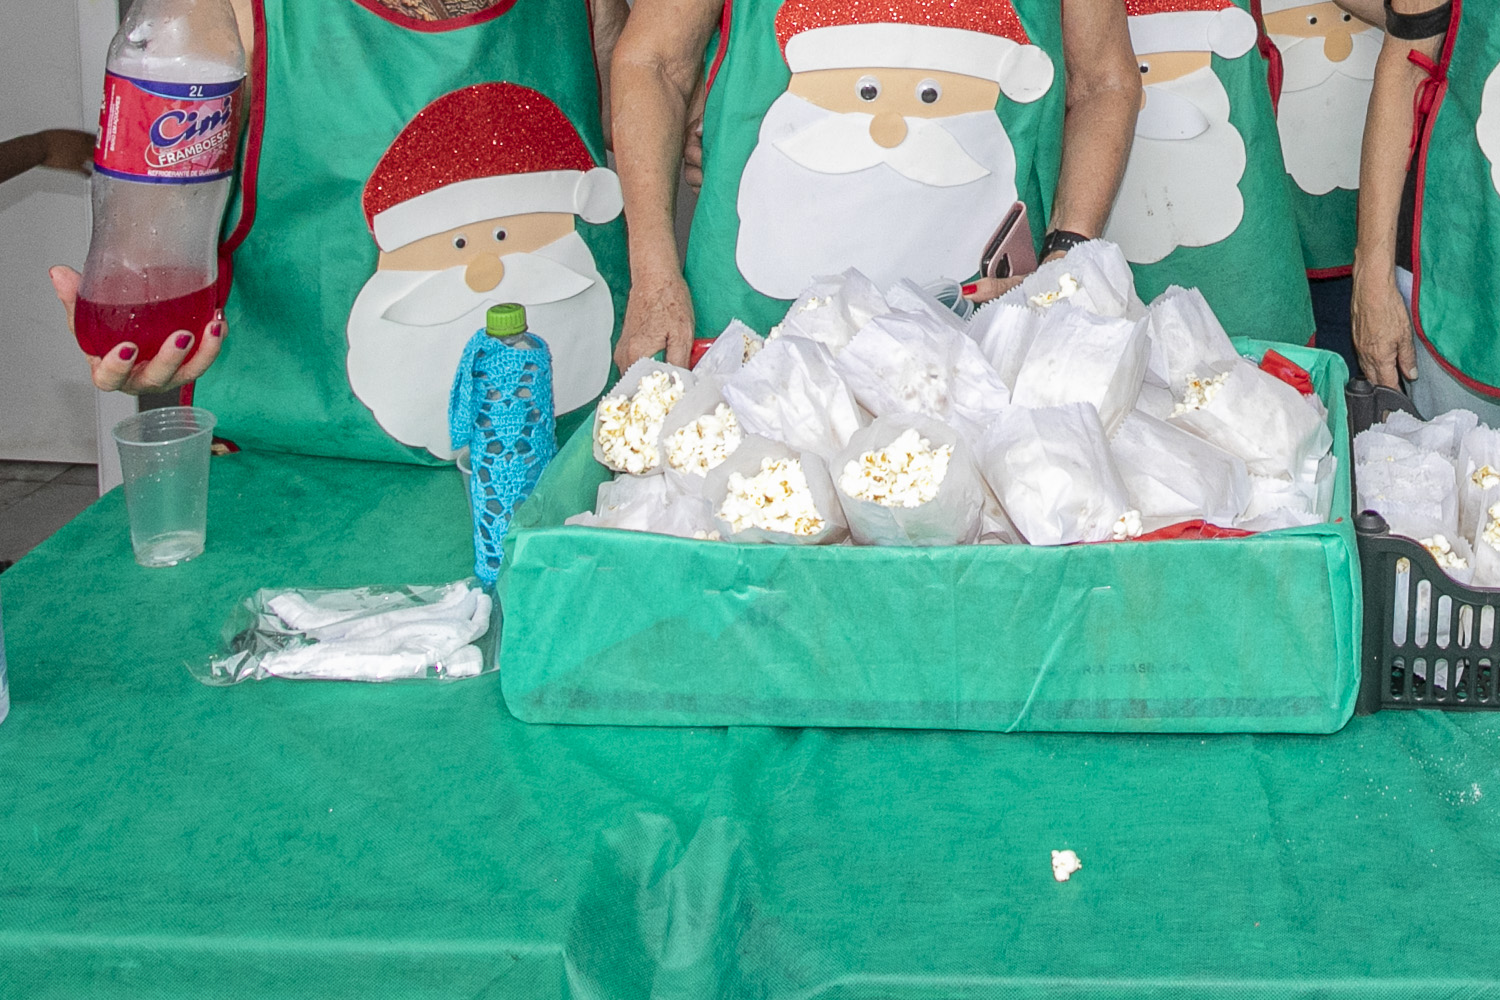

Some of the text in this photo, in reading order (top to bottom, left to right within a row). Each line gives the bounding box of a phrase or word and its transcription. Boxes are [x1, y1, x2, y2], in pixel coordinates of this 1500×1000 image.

[189, 85, 204, 98] 2L
[149, 95, 233, 149] Cini
[158, 129, 229, 166] FRAMBOESA
[147, 169, 191, 178] REFRIGERANTE
